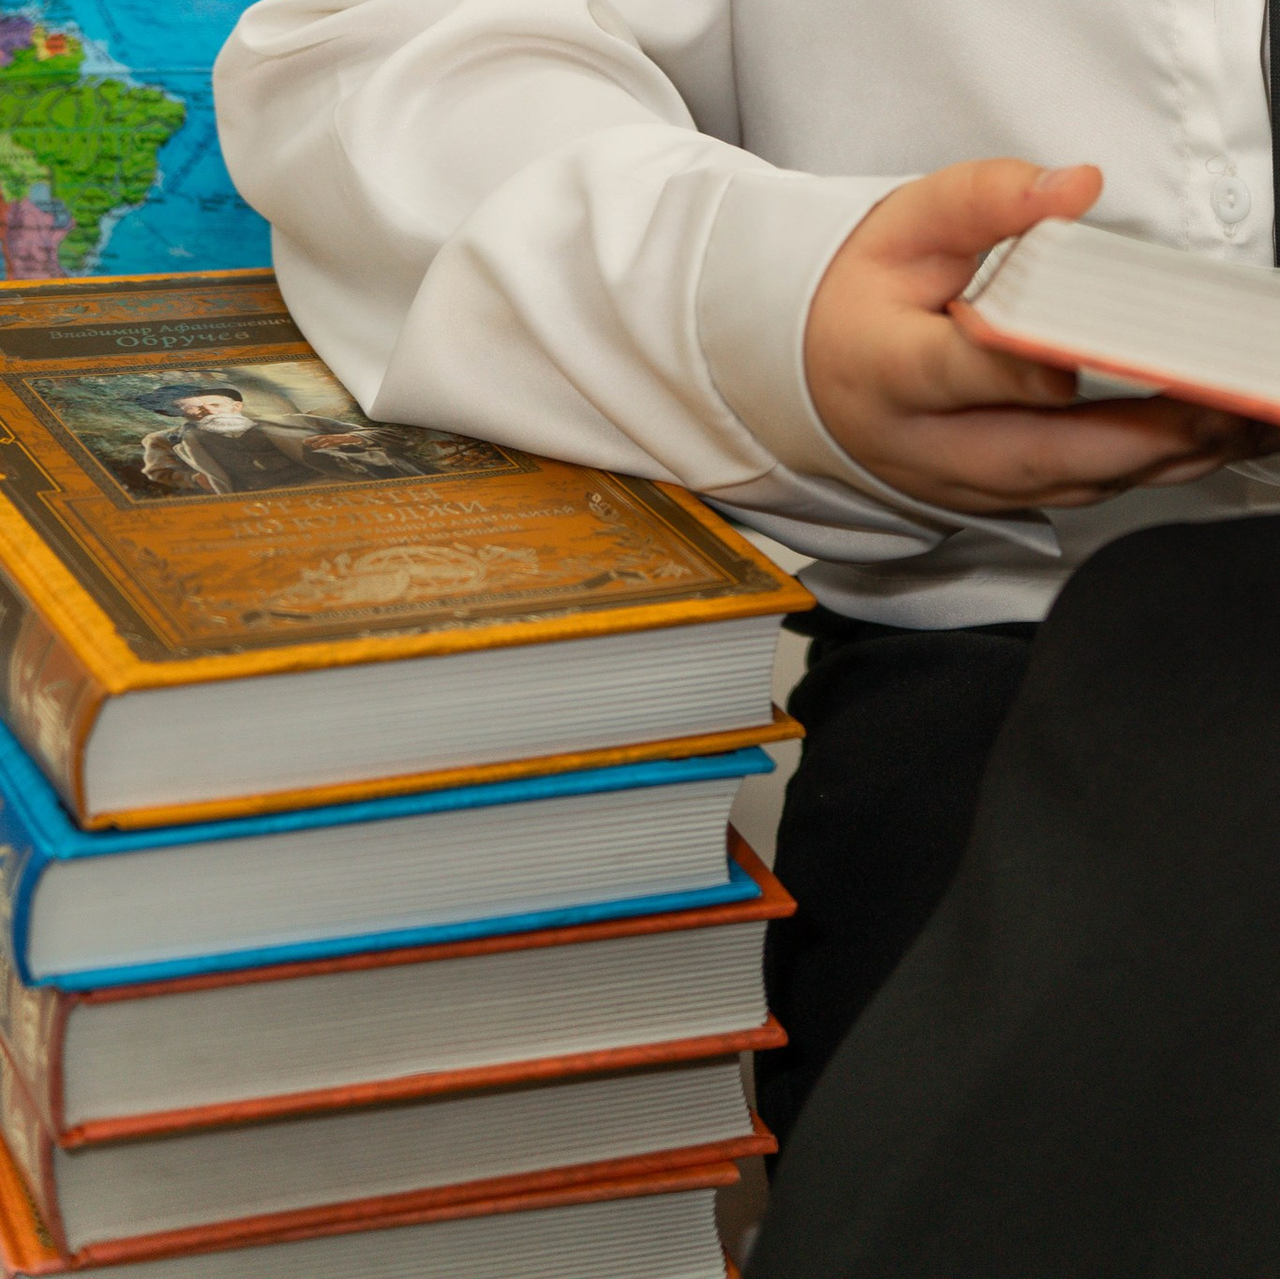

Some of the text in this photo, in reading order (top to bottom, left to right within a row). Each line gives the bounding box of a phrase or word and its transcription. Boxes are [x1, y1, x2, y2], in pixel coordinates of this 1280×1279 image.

[49, 317, 292, 341] Владимир Афанасьевич
[115, 331, 250, 348] Обручев
[243, 488, 443, 518] ОТ КЯХТЫ
[293, 500, 487, 531] КУЛЬДЖИ
